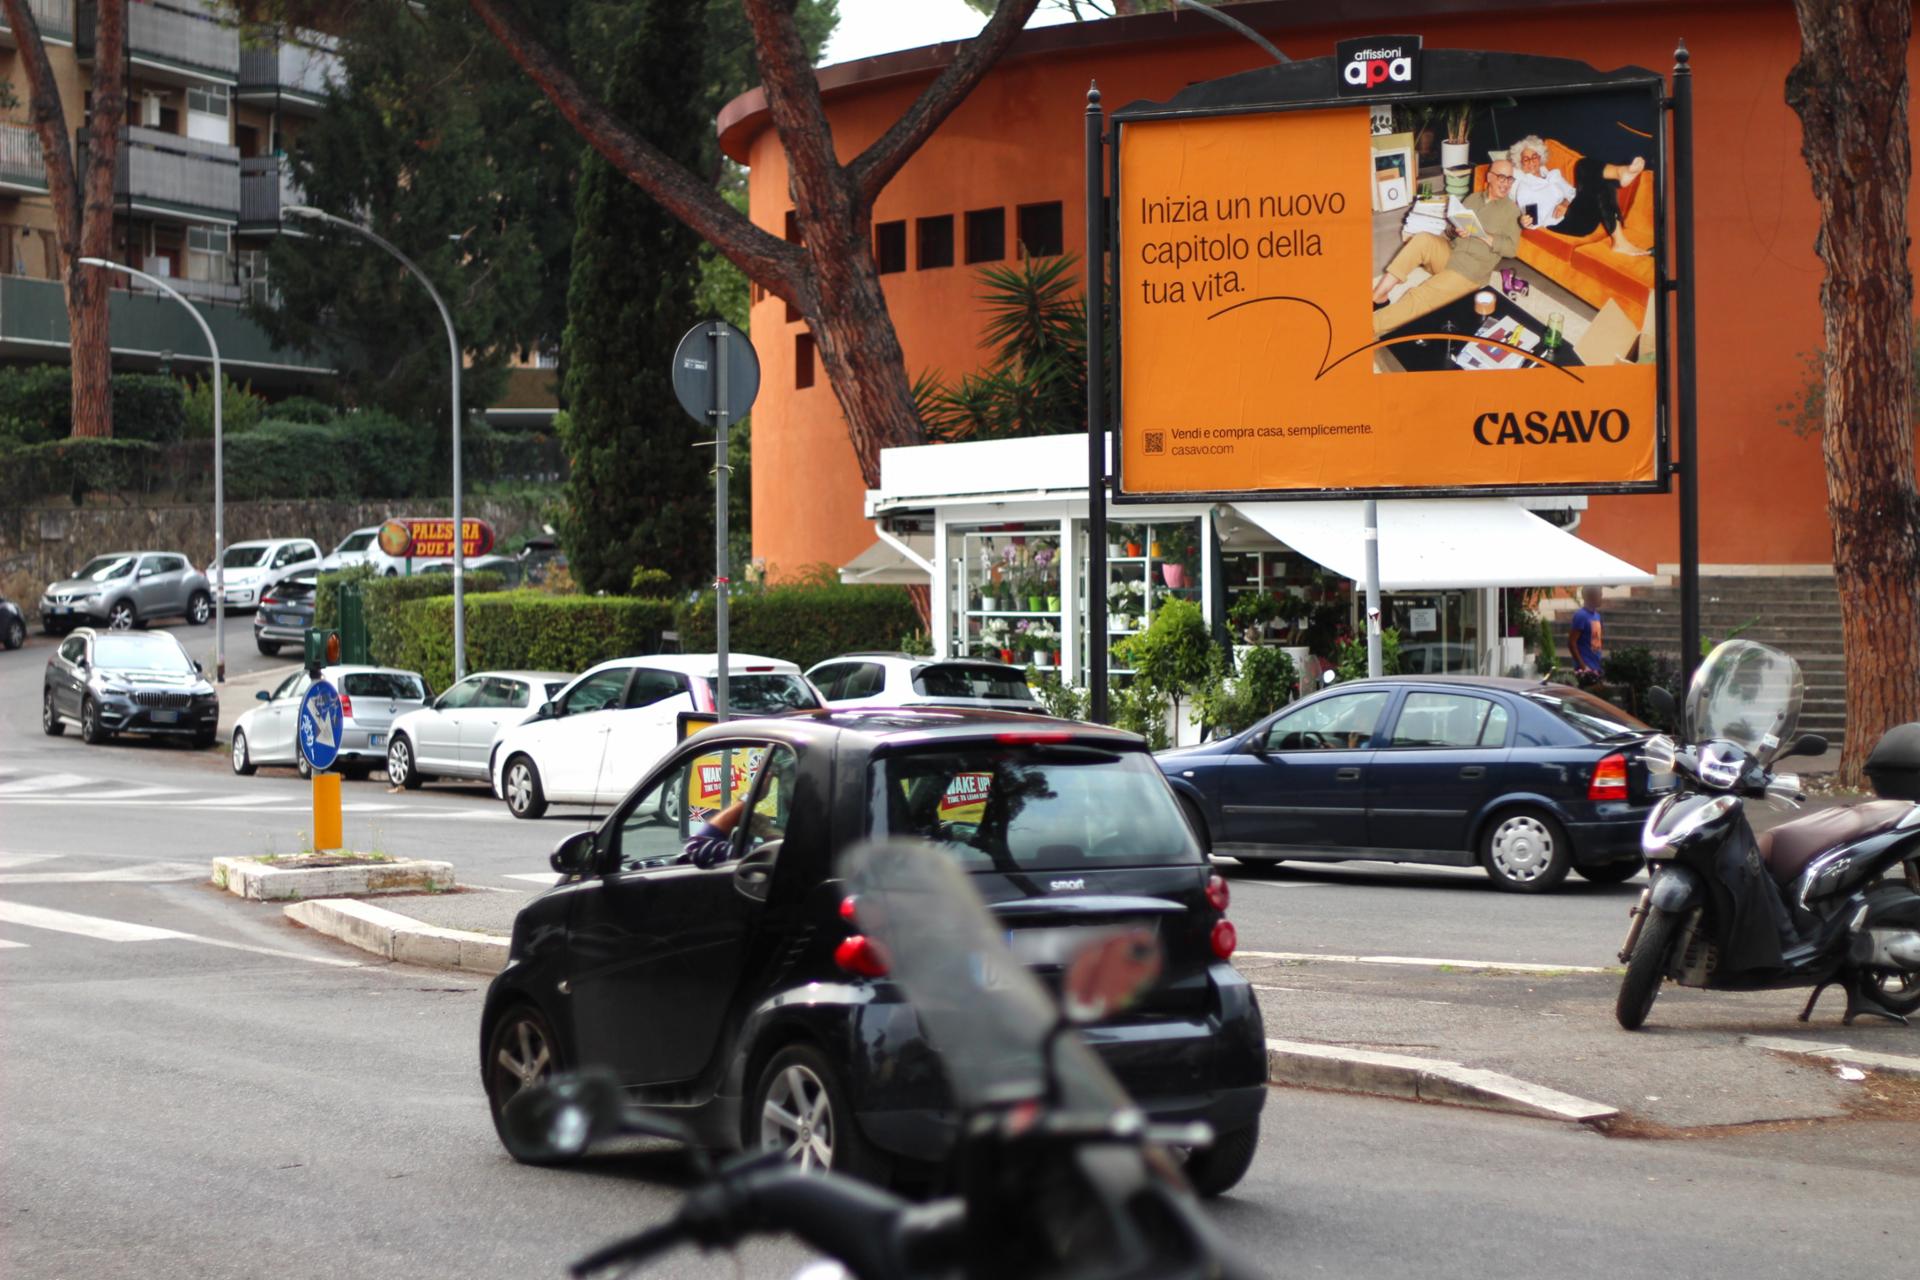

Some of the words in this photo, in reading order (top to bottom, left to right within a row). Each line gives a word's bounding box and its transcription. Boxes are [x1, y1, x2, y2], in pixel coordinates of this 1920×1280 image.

[1354, 46, 1402, 61] affissioni
[1344, 57, 1411, 89] apa
[1141, 195, 1209, 224] Inizia
[1216, 196, 1250, 221] un
[1259, 192, 1346, 218] nuovo
[1141, 233, 1249, 269] capitolo
[1257, 229, 1323, 259] della
[1141, 279, 1185, 304] tua
[1192, 270, 1246, 301] vita.
[1171, 428, 1202, 439] Vendi
[1203, 428, 1211, 438] e
[1212, 426, 1255, 440] compra
[1256, 426, 1286, 437] casa,
[1287, 423, 1374, 437] semplicemente.
[1473, 408, 1631, 446] CASAVO
[1171, 443, 1235, 456] casavo.com
[412, 523, 480, 539] PALESRA
[416, 542, 444, 555] DUE
[447, 542, 474, 555] PNI
